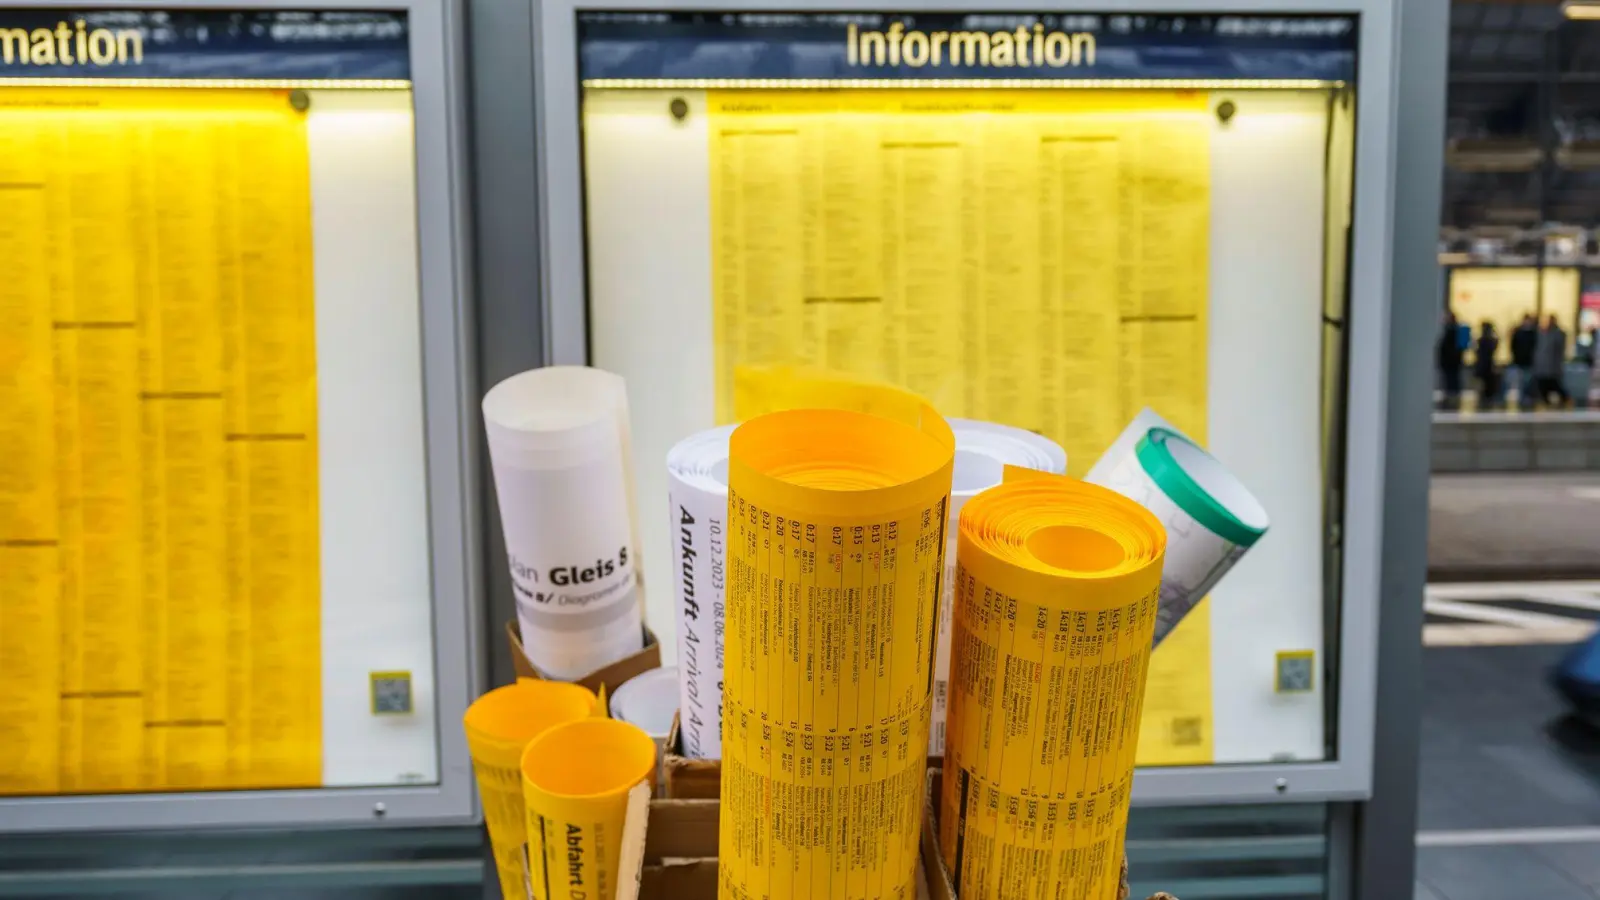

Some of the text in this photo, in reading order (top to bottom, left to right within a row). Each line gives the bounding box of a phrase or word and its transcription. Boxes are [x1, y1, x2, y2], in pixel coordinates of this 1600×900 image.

[0, 19, 143, 66] mation
[847, 22, 1096, 67] Information
[791, 520, 800, 540] 0:17
[806, 524, 815, 543] 0:17
[832, 526, 841, 545] 0:17
[854, 526, 862, 545] 0:15
[872, 525, 881, 543] 0:13
[888, 521, 897, 540] 0:12
[680, 504, 700, 621] Ankunft
[709, 518, 724, 589] 10.12.2023
[549, 558, 614, 588] Gleis
[994, 592, 1002, 613] 14:21
[1007, 598, 1016, 620] 14:20
[1037, 607, 1047, 628] 14:20
[1060, 610, 1070, 632] 14:18
[1076, 611, 1086, 633] 14:17
[1096, 611, 1106, 632] 14:15
[1112, 608, 1120, 630] 14:14
[713, 601, 725, 669] 08.06.2024
[685, 622, 703, 709] Arrival
[761, 712, 767, 720] 20
[790, 720, 797, 729] 15
[804, 723, 812, 731] 10
[880, 729, 888, 744] 5:20
[785, 731, 793, 747] 5:24
[804, 734, 812, 750] 5:23
[825, 736, 833, 752] 5:22
[842, 735, 850, 751] 5:21
[990, 790, 999, 809] 15:58
[1009, 796, 1018, 815] 15:58
[1058, 792, 1065, 800] 22
[1028, 800, 1037, 819] 15:56
[1047, 802, 1056, 820] 15:53
[1068, 802, 1076, 820] 15:53
[1086, 799, 1094, 817] 15:52
[566, 823, 585, 886] Abfahrt
